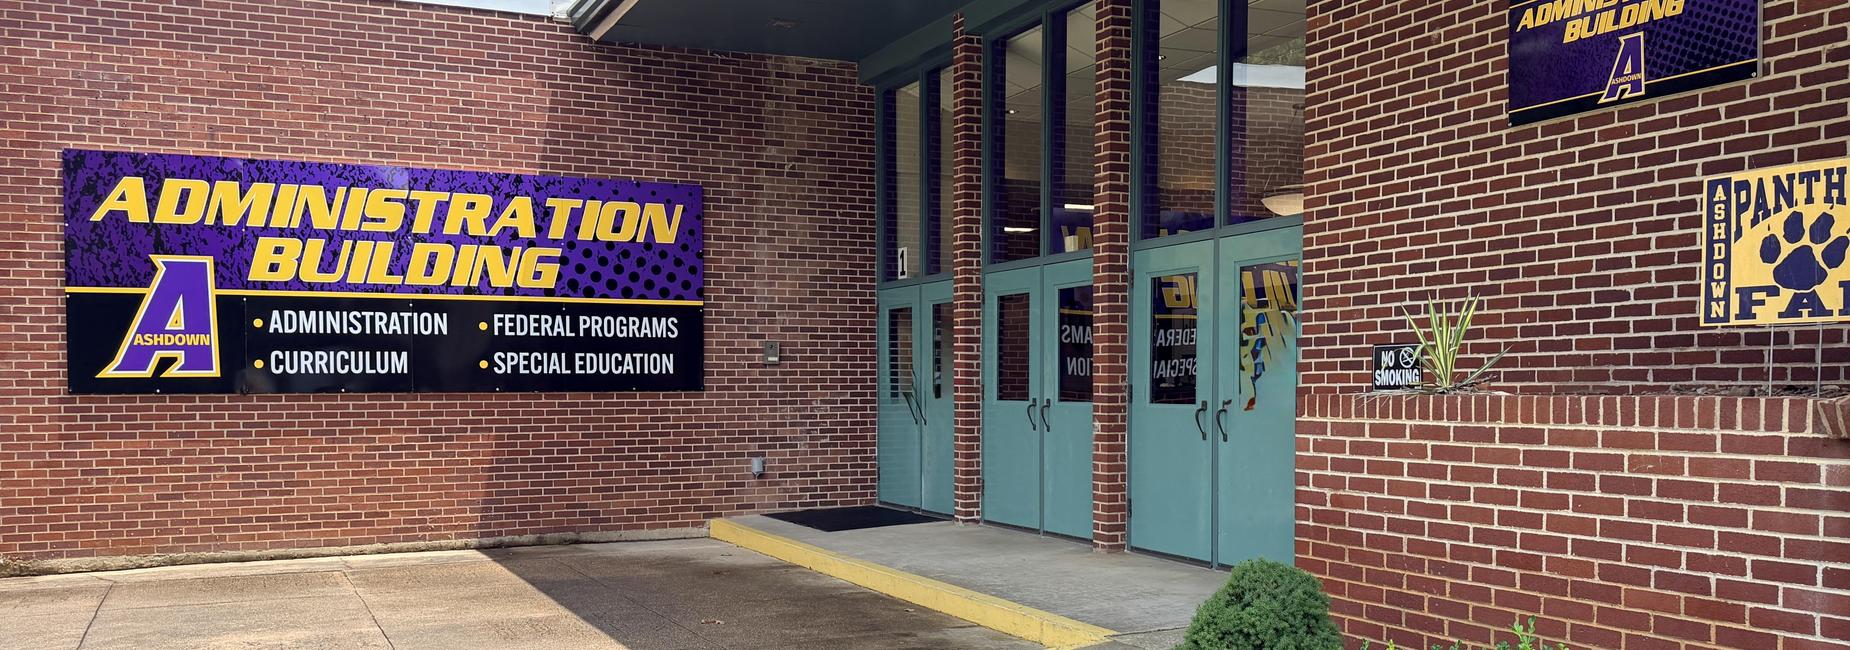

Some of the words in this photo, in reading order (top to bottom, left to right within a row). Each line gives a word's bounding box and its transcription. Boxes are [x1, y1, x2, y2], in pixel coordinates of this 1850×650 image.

[1563, 0, 1685, 44] BUILDING
[1597, 31, 1646, 104] A
[1611, 73, 1643, 85] ASHDOWN
[89, 176, 684, 244] ADMINISTRATION
[247, 236, 562, 289] BUILDING
[899, 249, 906, 277] 1
[1710, 184, 1727, 319] ASHDOWN
[1735, 280, 1850, 320] FA
[95, 254, 221, 378] A
[269, 310, 448, 335] ADMINISTRATION
[493, 314, 576, 337] FEDERAL
[579, 315, 679, 339] PROGRAMS
[133, 333, 210, 346] ASHDOWN
[270, 350, 408, 375] CURRICULUM
[493, 352, 571, 374] SPECIAL
[575, 353, 674, 375] EDUCATION
[1381, 350, 1395, 367] NO
[1375, 368, 1420, 386] SMOKING
